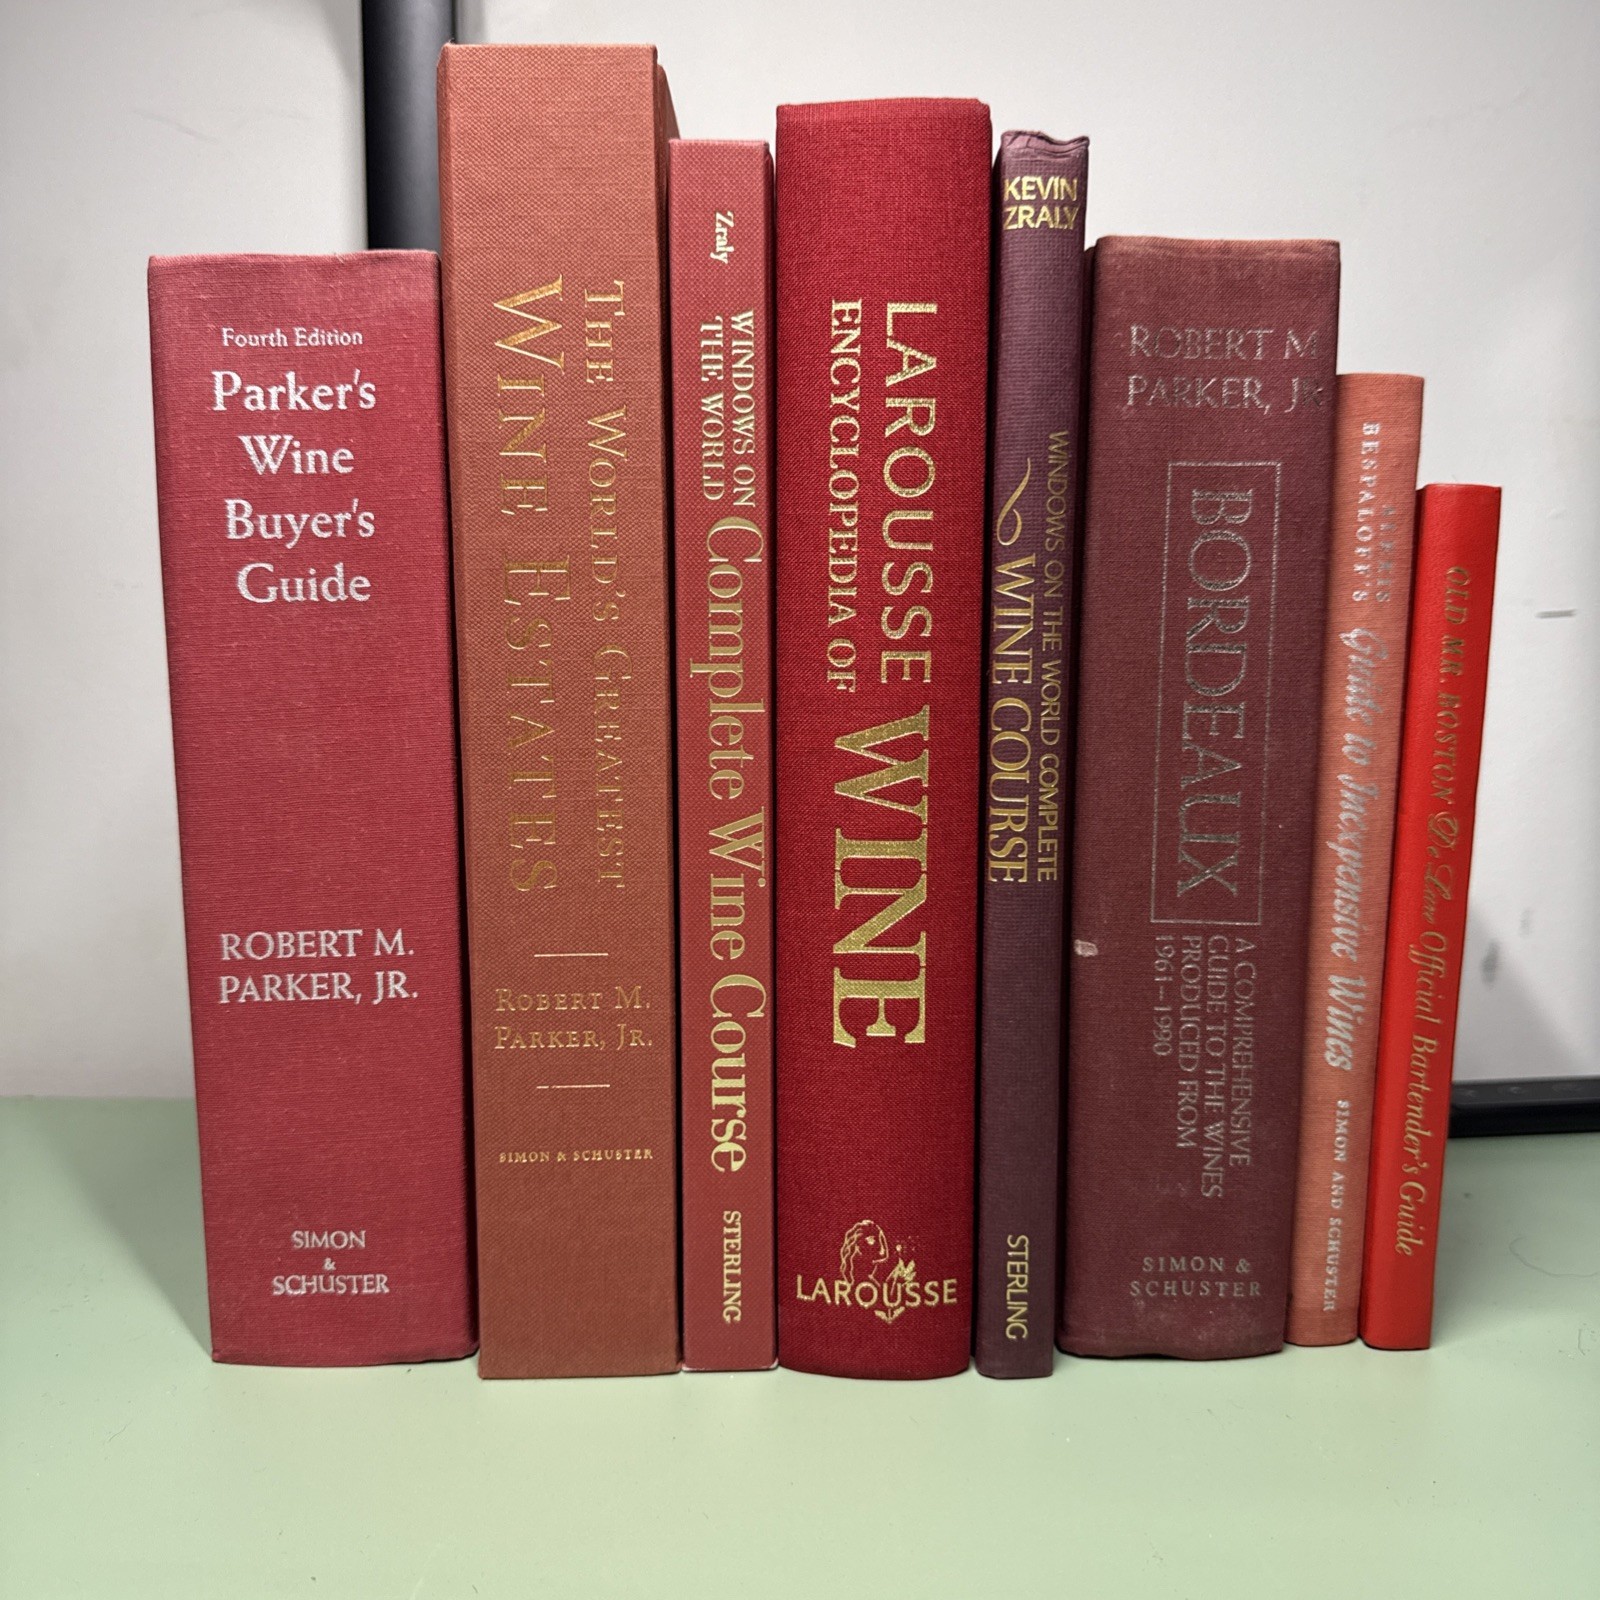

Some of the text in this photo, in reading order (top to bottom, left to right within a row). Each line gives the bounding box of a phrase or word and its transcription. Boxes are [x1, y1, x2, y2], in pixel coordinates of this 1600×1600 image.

[1003, 176, 1078, 201] KEVIN
[1003, 205, 1080, 230] ZRALY
[710, 211, 734, 264] Zraly
[222, 327, 363, 347] Fourth Edition
[1129, 324, 1274, 359] ROBERT
[211, 368, 377, 412] Parker's
[700, 315, 725, 500] THE WORLD
[731, 310, 756, 507] WINDOWS ON
[1127, 374, 1270, 415] PARKER,
[238, 434, 354, 475] Wine
[826, 298, 863, 692] ENCYCLOPEDIA OF
[881, 301, 938, 684] LAROUSSE
[224, 498, 375, 549] Buyer's
[236, 562, 372, 603] Guide
[1445, 565, 1471, 625] OLD
[1037, 430, 1070, 881] WINDOWS ON THE WORLD COMPLETE
[987, 553, 1036, 882] WINE COURSE
[1177, 489, 1254, 897] BORDEAUX
[1431, 692, 1461, 804] BOSTON
[689, 516, 767, 1172] Complete Wine Course
[1324, 627, 1389, 1071] Guide to Inexpensive Wines
[833, 704, 930, 1048] WINE
[220, 928, 415, 961] ROBERT M.
[219, 971, 418, 1005] PARKER, JR.
[615, 985, 651, 1010] M.
[1408, 931, 1447, 1025] Official
[1176, 935, 1202, 1148] PRODUCED FROM
[1200, 935, 1229, 1197] GUIDE TO THE WINES
[1229, 938, 1257, 1166] A COMPREHENSIVE
[1402, 1032, 1438, 1175] Bartender's
[499, 1148, 654, 1163] SIMON & SCHUSTER
[1322, 1099, 1350, 1312] SIMON AND SCHUSTER
[1396, 1181, 1427, 1256] Guide
[291, 1230, 366, 1250] SIMON
[323, 1258, 336, 1271] &
[723, 1210, 742, 1324] STERLING
[1142, 1256, 1251, 1274] SIMON &
[272, 1274, 390, 1297] SCHUSTER
[796, 1274, 958, 1309] LAROUSSE
[1005, 1234, 1029, 1339] STERLING
[1129, 1280, 1262, 1297] SCHUSTER
